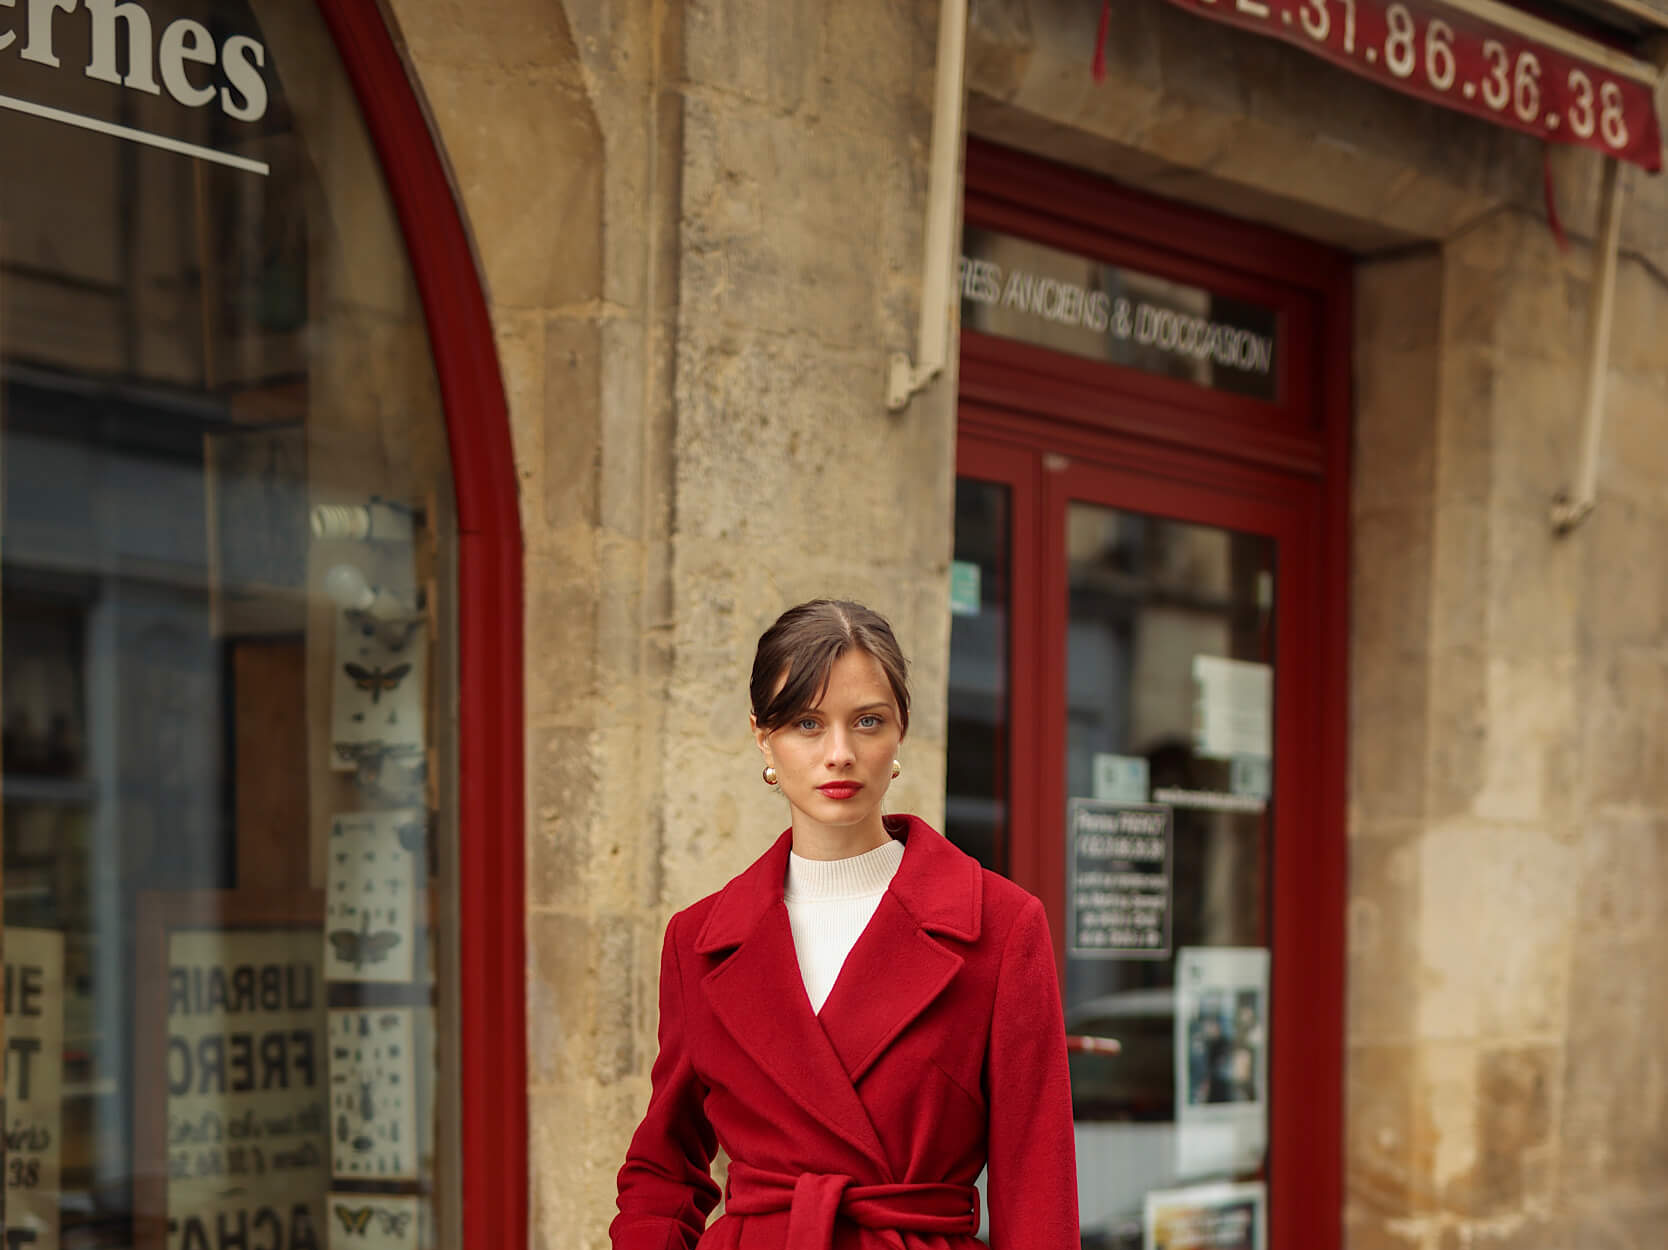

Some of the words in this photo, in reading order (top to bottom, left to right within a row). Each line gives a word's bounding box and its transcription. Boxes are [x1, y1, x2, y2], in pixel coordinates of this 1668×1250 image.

[0, 0, 268, 122] rnes
[1198, 0, 1630, 149] .31.86.36.38
[1004, 270, 1109, 332] ANCIENS
[1111, 298, 1134, 340] &
